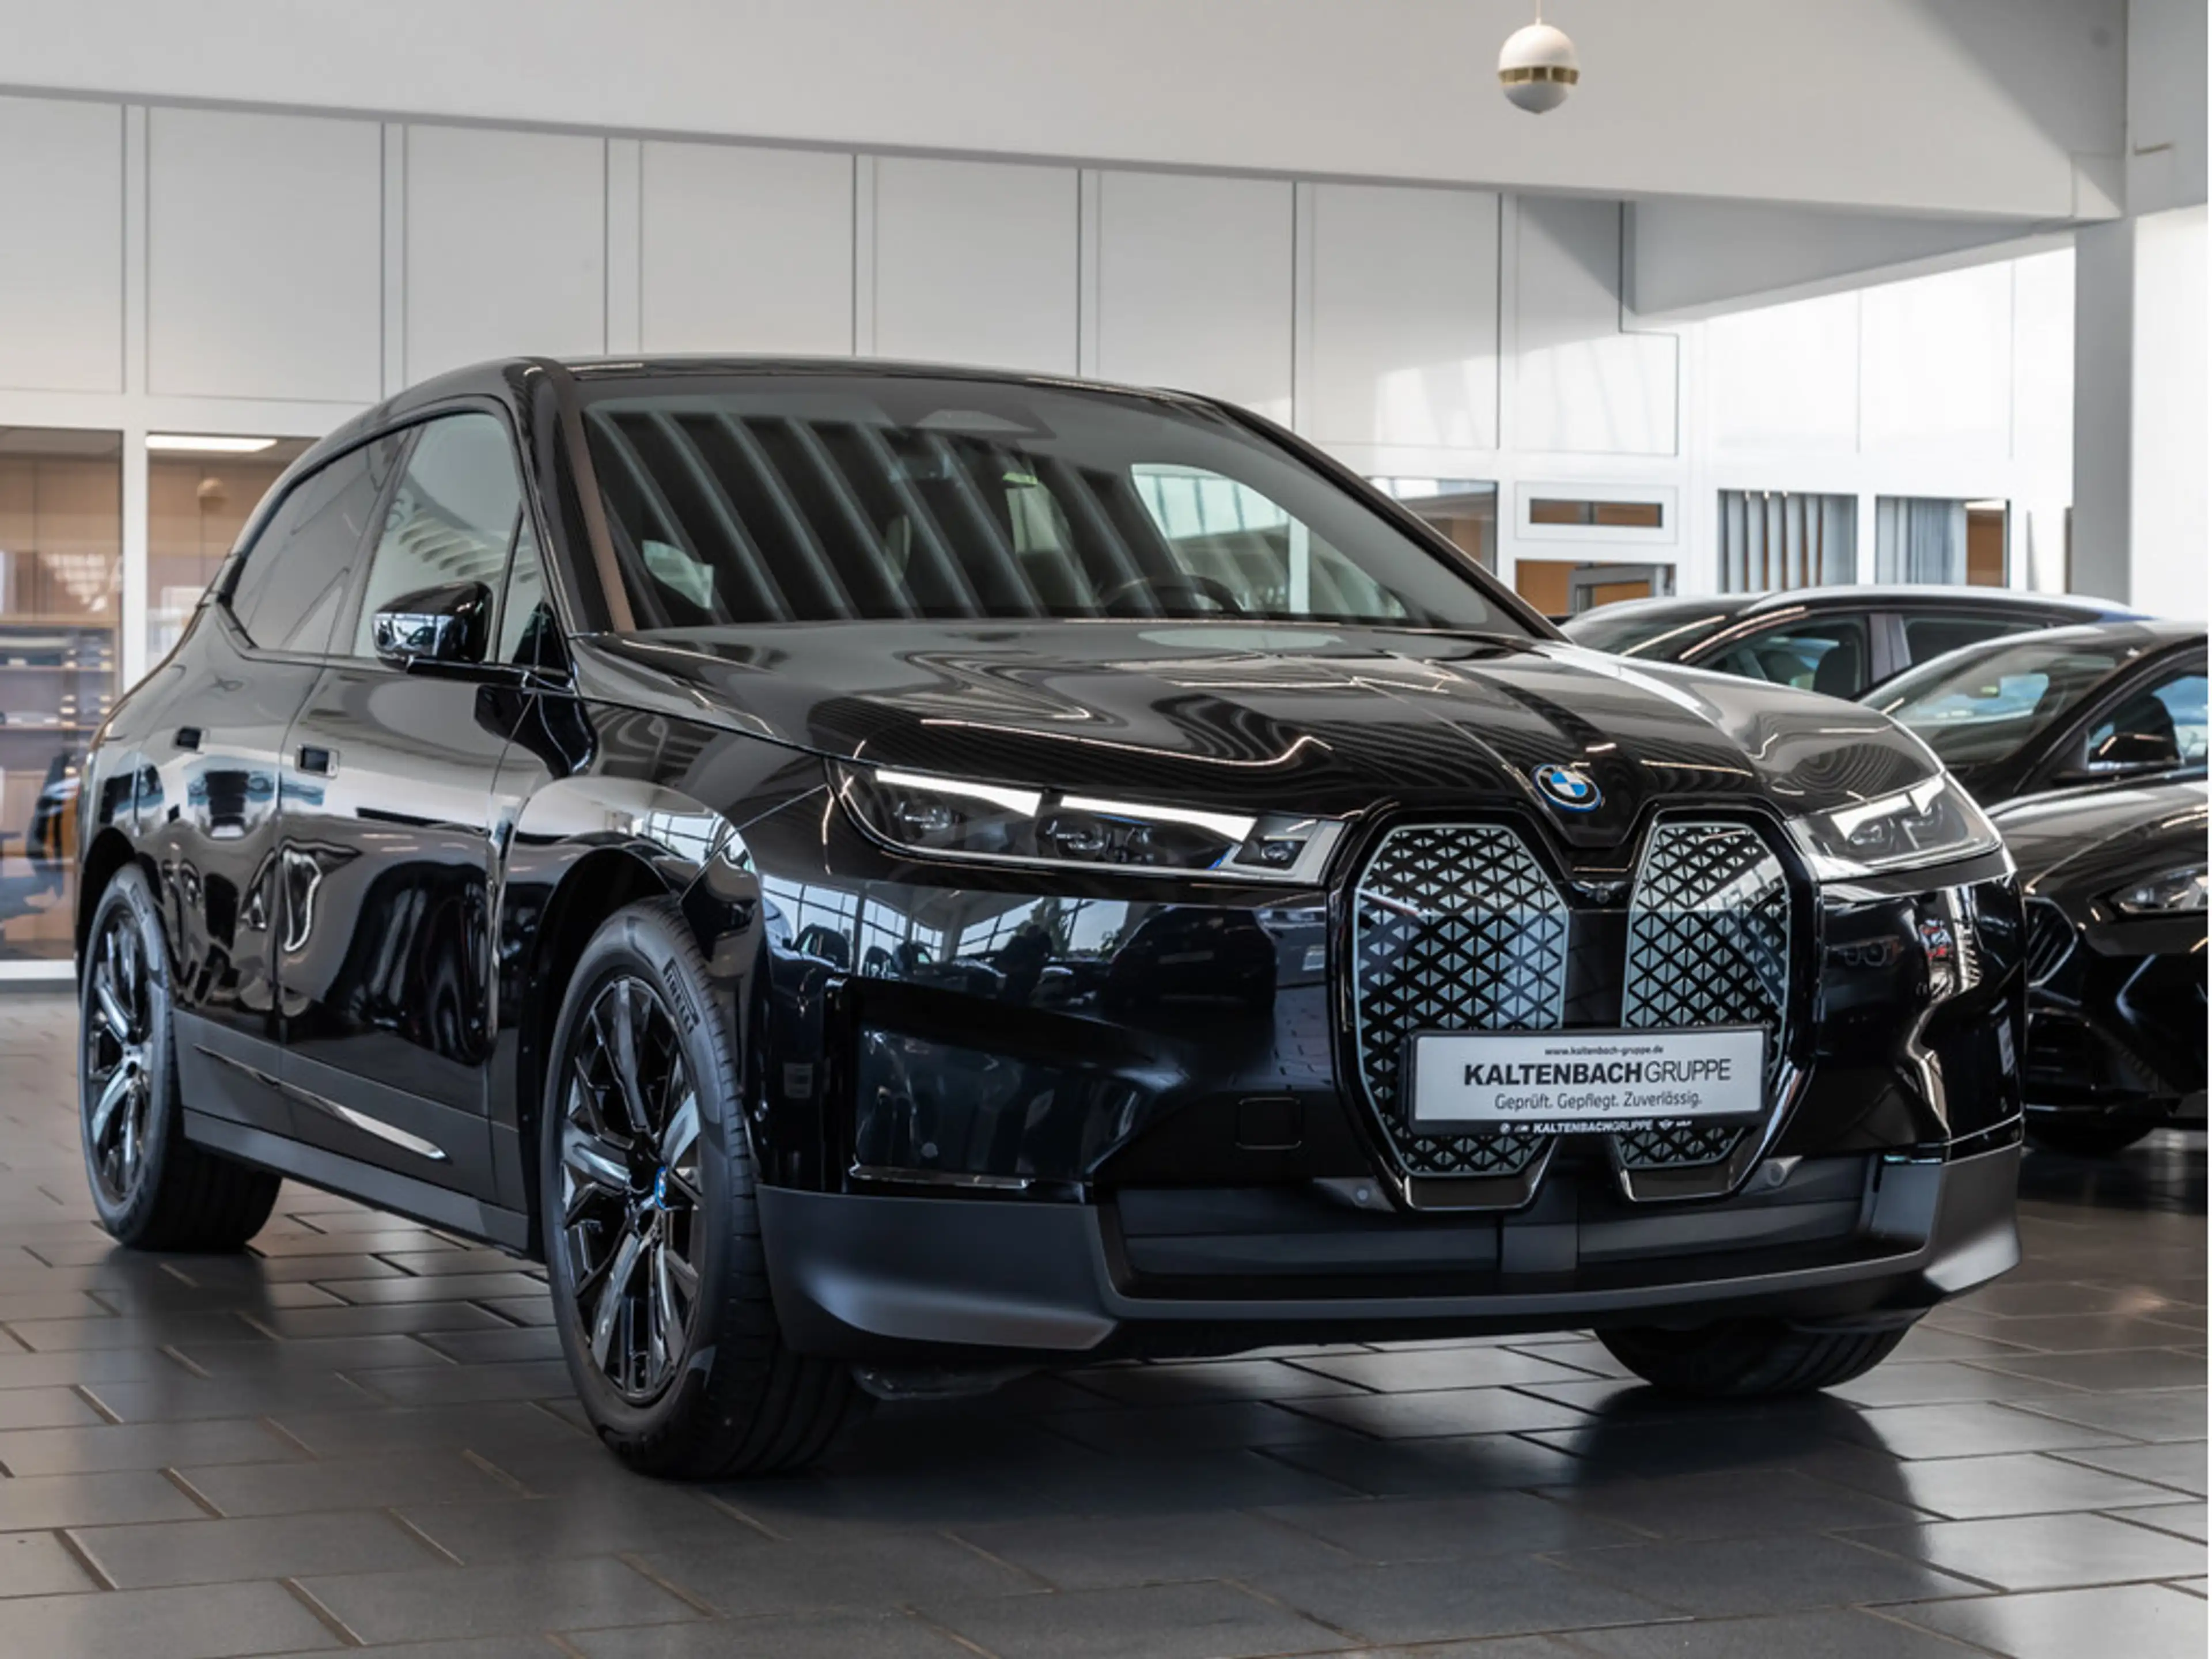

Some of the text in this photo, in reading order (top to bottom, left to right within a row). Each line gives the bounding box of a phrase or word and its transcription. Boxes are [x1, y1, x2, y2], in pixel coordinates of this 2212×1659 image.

[1544, 1044, 1664, 1056] www.kaltenbach-gruppe.de
[1495, 1089, 1702, 1112] Geprüft. Gepflegt. Zuverlässig.
